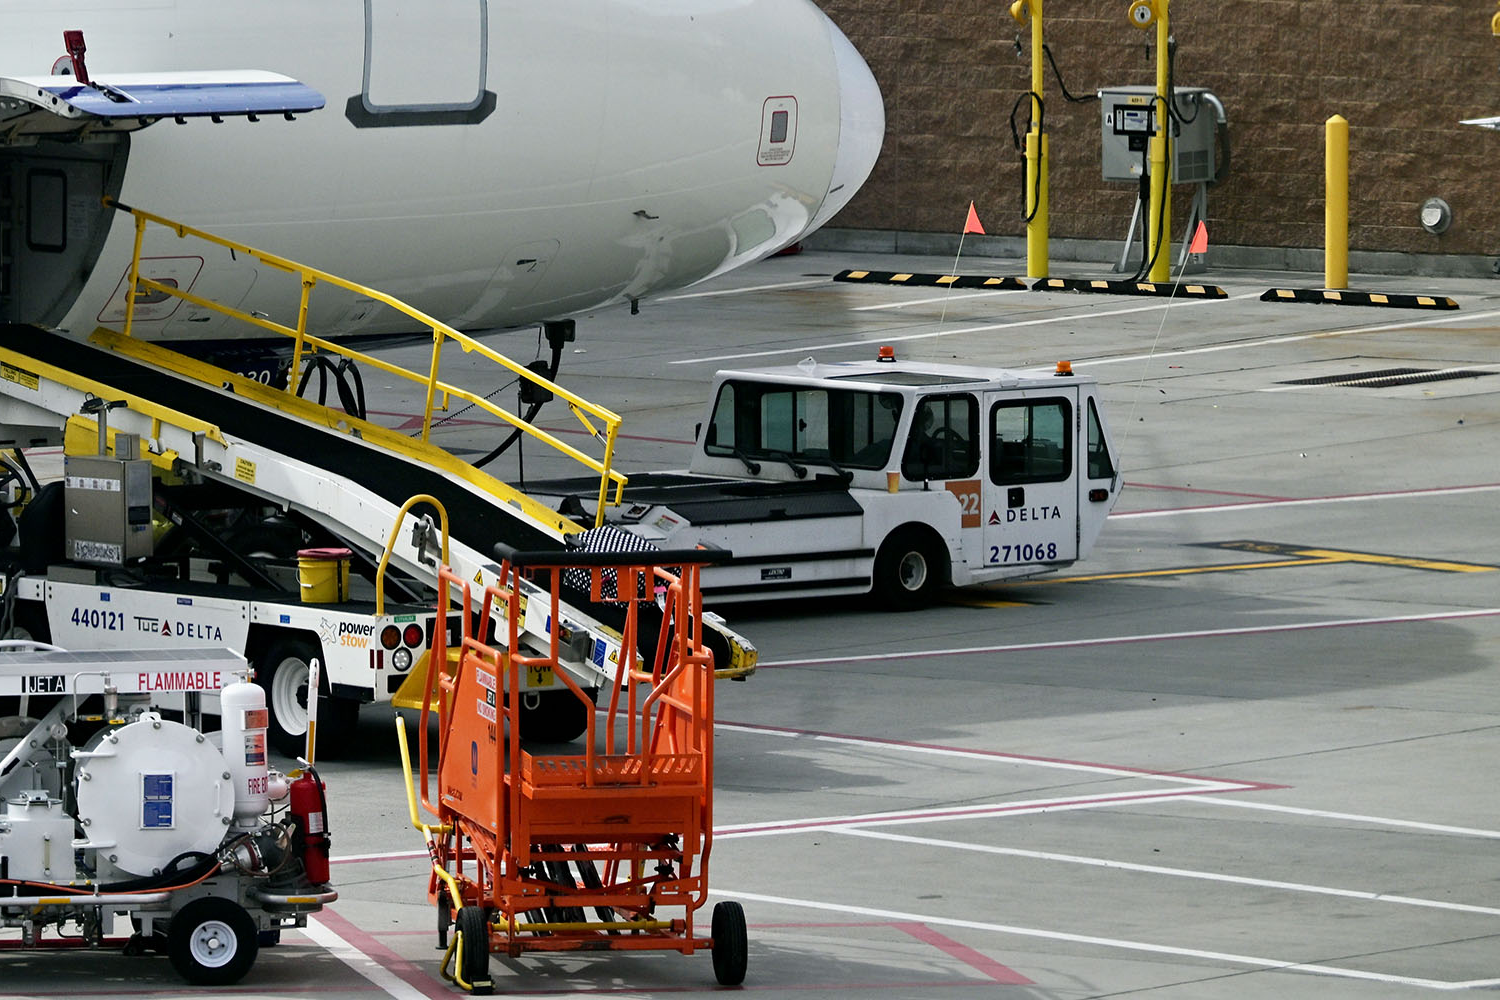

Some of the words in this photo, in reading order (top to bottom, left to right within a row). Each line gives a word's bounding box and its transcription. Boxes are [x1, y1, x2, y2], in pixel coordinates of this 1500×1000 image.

[960, 493, 979, 515] 22
[1006, 506, 1061, 522] DELTA
[990, 543, 1057, 563] 271068
[71, 607, 124, 631] 440121
[176, 621, 222, 641] DELTA
[339, 621, 375, 636] power
[340, 633, 368, 648] stow
[29, 676, 50, 693] JET
[51, 676, 65, 692] A
[138, 672, 221, 692] FLAMMABLE
[248, 778, 260, 795] FIRE
